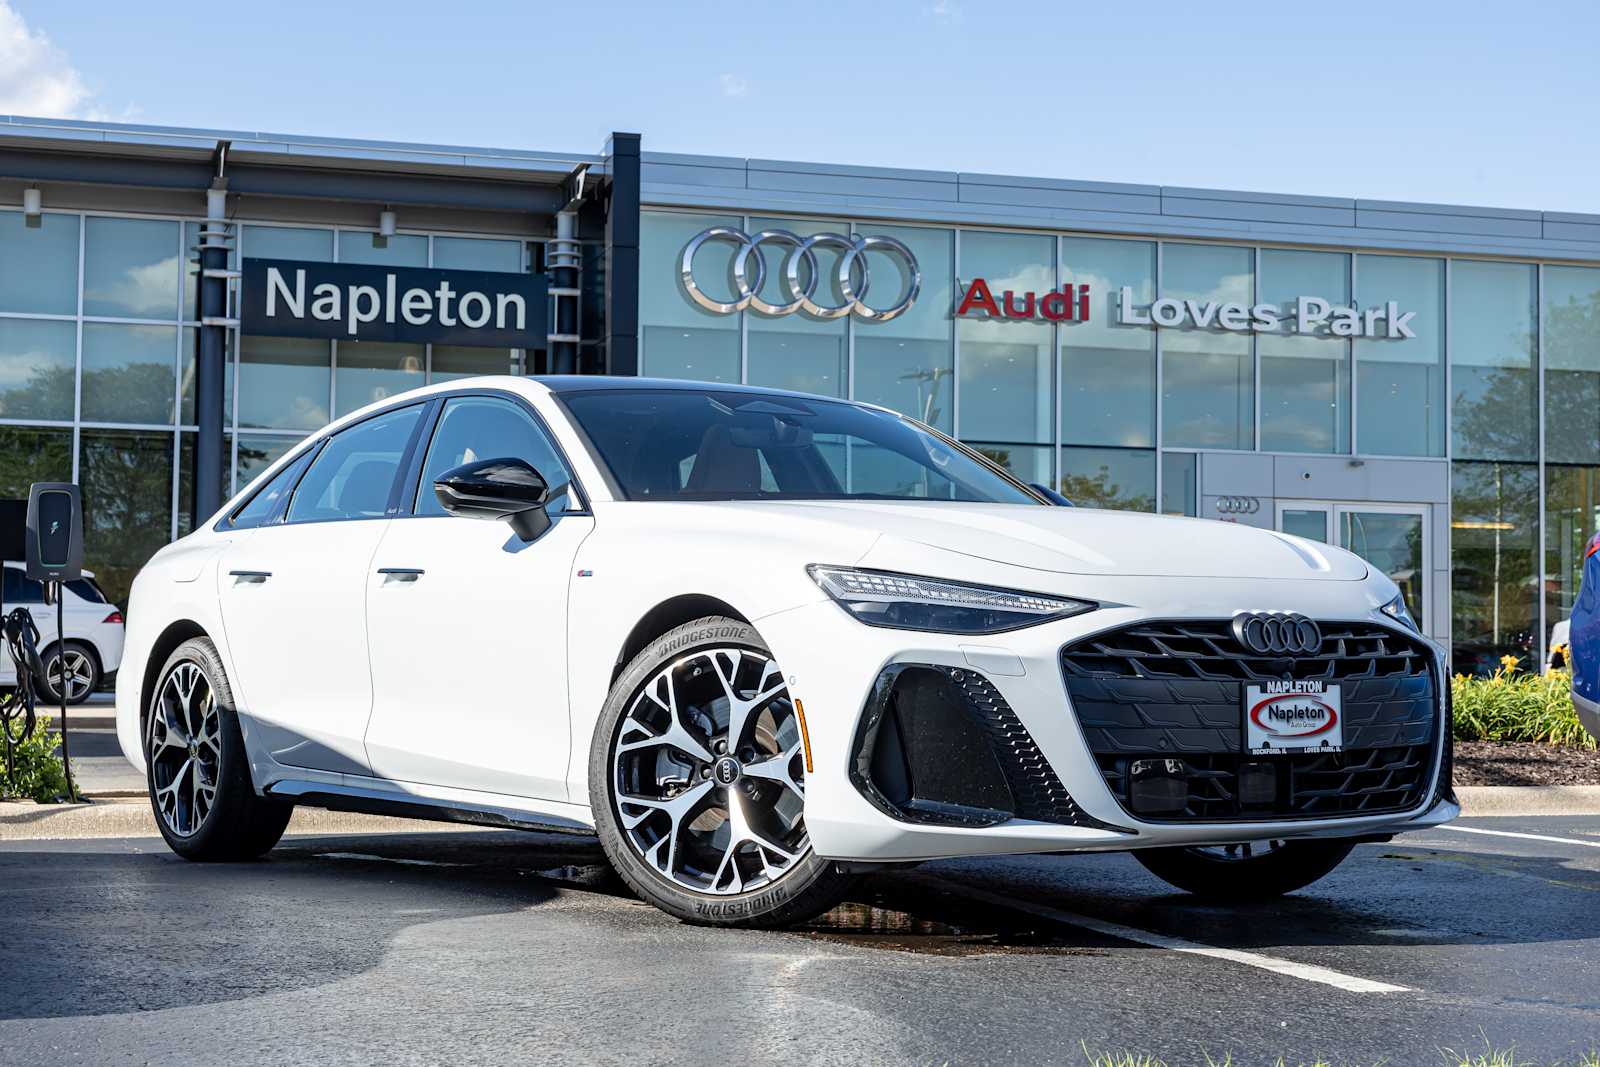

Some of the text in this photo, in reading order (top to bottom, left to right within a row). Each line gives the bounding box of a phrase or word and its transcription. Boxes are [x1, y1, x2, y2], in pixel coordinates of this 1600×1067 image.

[266, 267, 526, 335] Napleton
[958, 278, 1417, 338] Audi Loves Park
[658, 626, 748, 658] BRIDGESTONE
[1267, 681, 1322, 693] NAPLETON
[1268, 704, 1325, 723] Napleton
[695, 886, 788, 917] BRIDGESTONE
